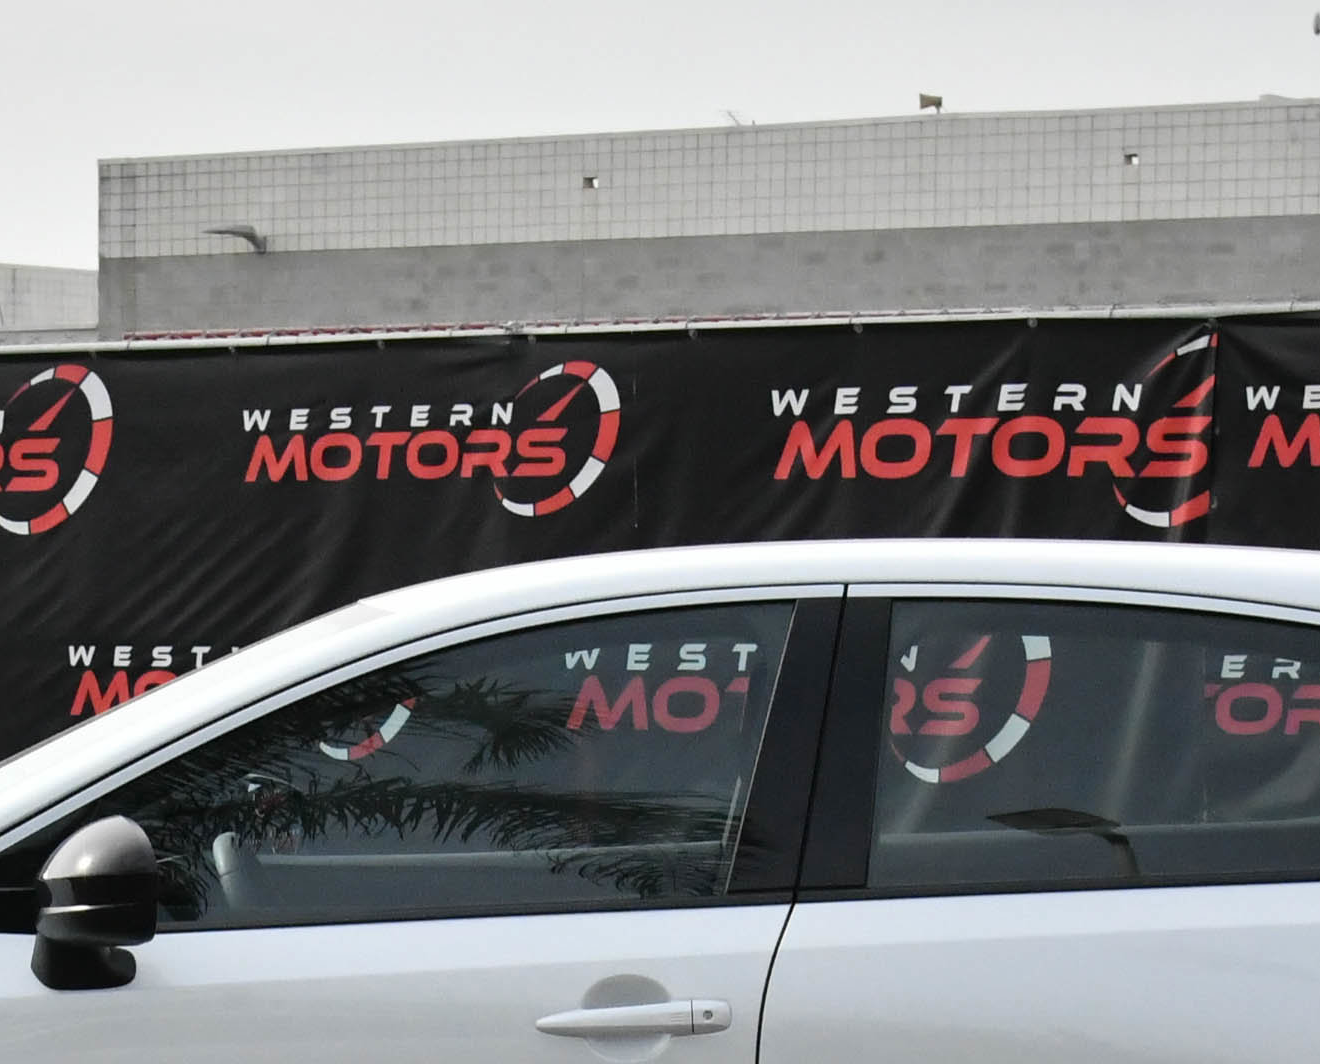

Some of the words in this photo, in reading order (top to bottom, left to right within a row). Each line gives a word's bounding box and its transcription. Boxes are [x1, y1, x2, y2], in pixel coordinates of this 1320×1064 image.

[771, 382, 1143, 416] WESTERN
[241, 401, 514, 432] WESTERN
[243, 426, 569, 482] MOTORS
[772, 414, 1213, 480] MOTORS
[68, 644, 241, 669] WEST
